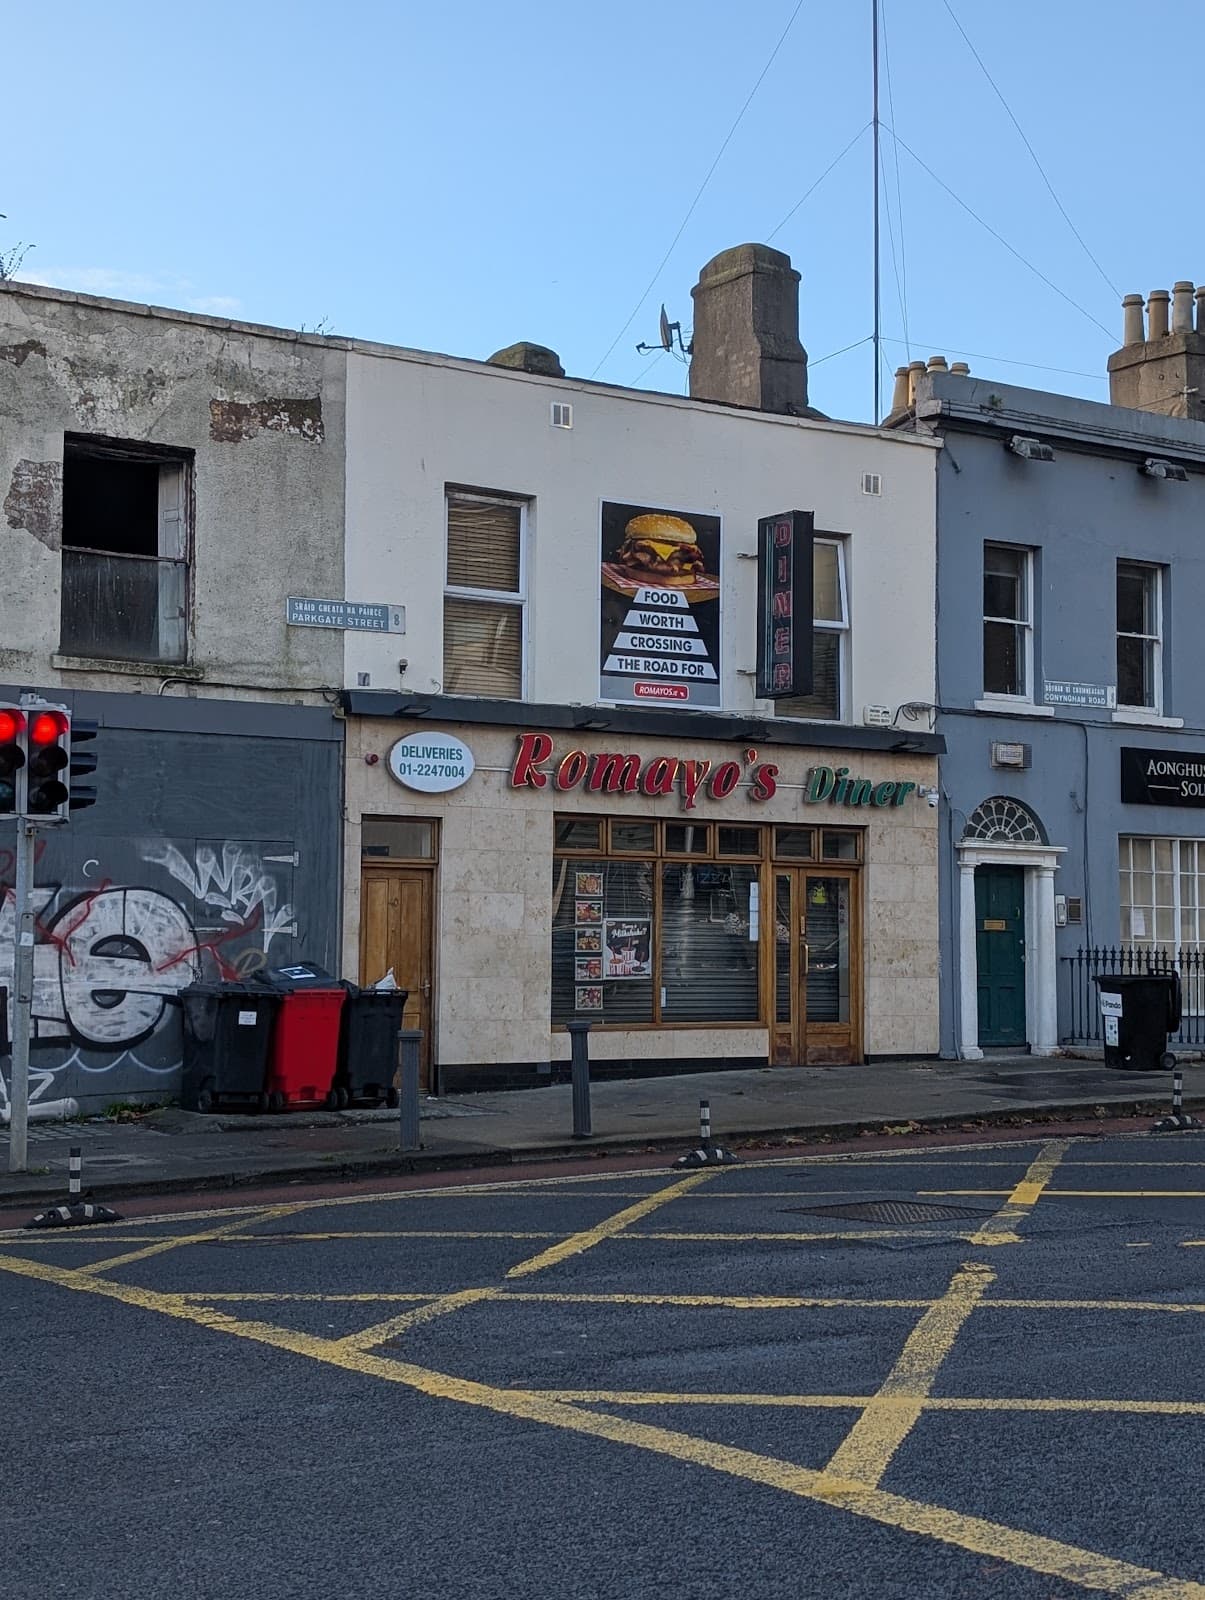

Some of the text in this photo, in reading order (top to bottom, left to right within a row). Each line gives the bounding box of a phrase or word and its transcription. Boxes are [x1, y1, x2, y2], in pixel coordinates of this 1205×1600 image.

[644, 591, 678, 605] FOOD
[773, 519, 792, 690] DINER
[294, 601, 382, 617] SRÁID GHEATA NA PÁIRCE
[292, 612, 385, 628] PARKGATE STREET
[393, 614, 400, 626] 8
[639, 613, 684, 628] WORTH
[630, 636, 692, 652] CROSSING
[617, 658, 704, 676] THE ROAD FOR
[1044, 693, 1106, 705] CONYNGHAM ROAD
[401, 745, 463, 761] DELIVERIES
[399, 762, 465, 778] 01-2247004
[511, 732, 919, 810] Romayo's Diner
[1146, 759, 1205, 778] AONGHU
